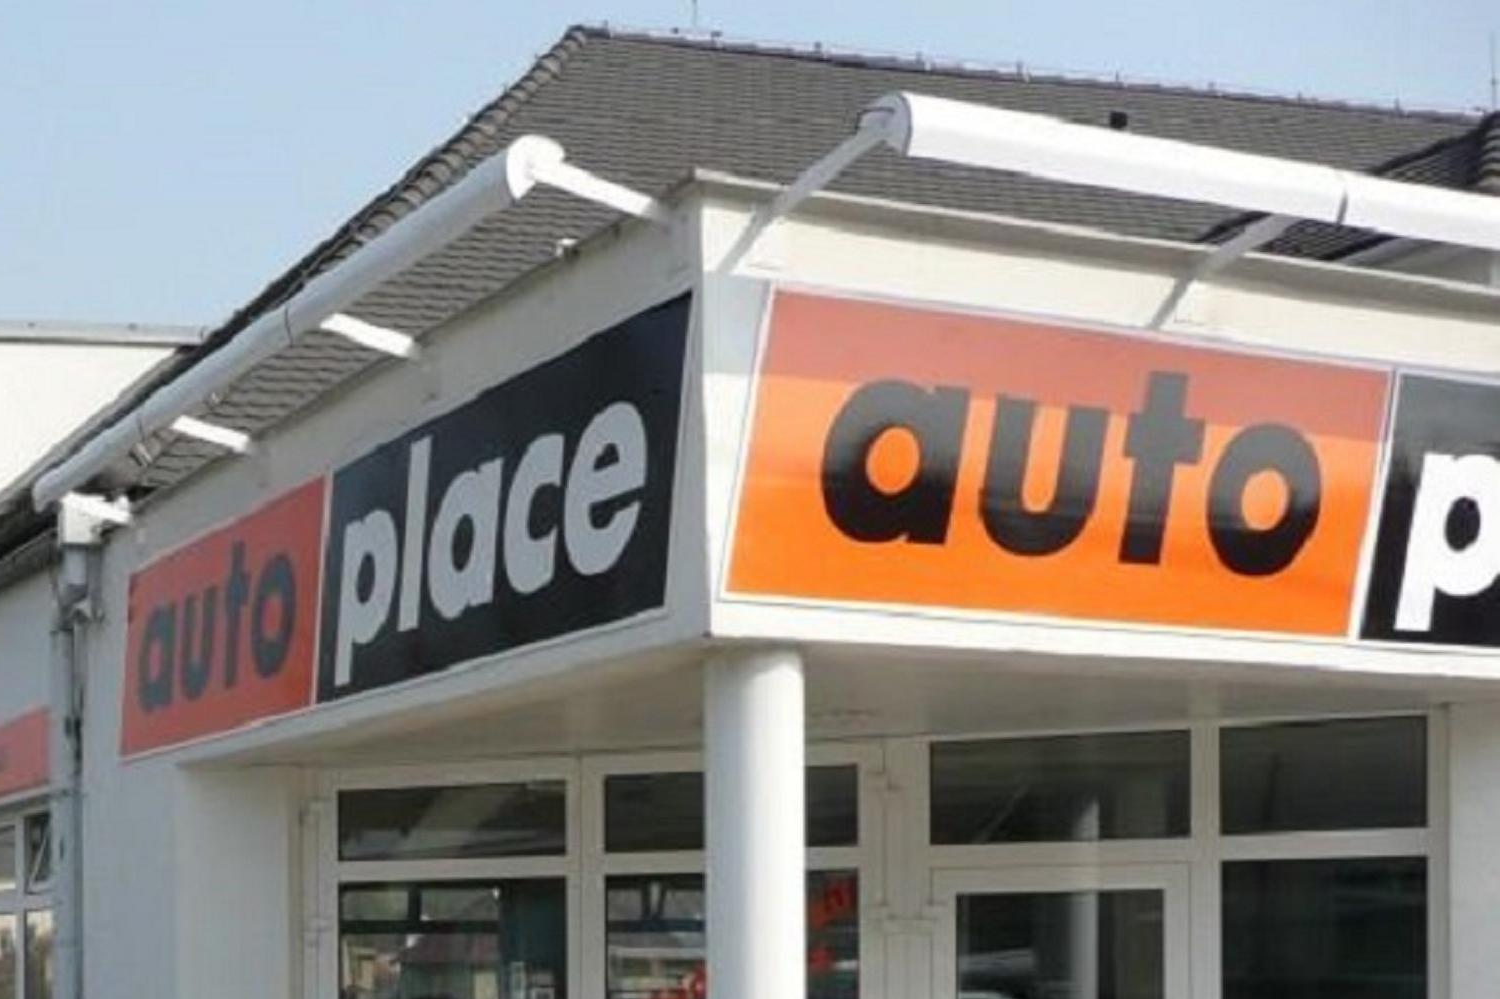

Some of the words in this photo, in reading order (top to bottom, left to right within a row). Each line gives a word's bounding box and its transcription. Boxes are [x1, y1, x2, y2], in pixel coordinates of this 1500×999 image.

[138, 541, 297, 714] auto
[334, 401, 647, 687] place
[820, 370, 1322, 577] auto
